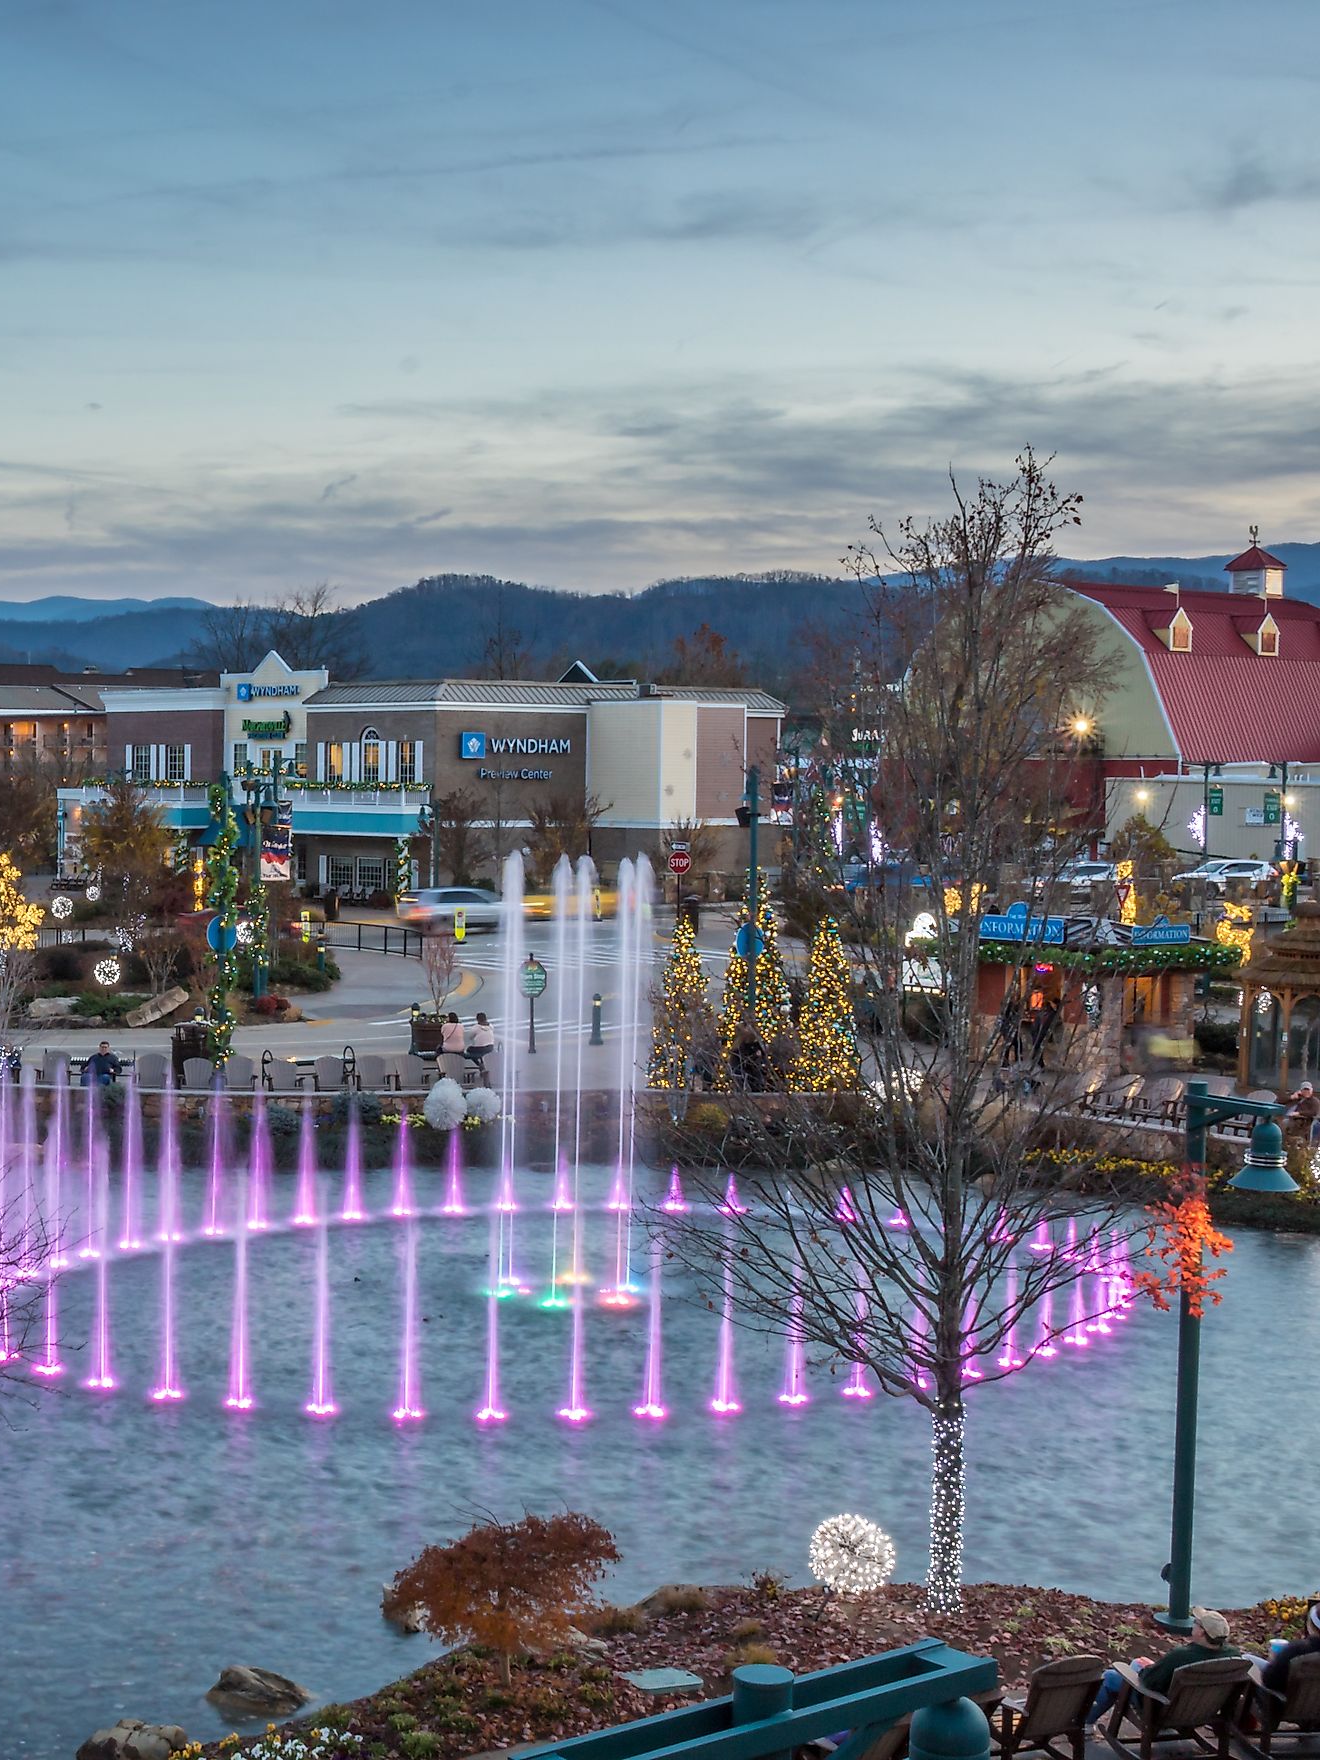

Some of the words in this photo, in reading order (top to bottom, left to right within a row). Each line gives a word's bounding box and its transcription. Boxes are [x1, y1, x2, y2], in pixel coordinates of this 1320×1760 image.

[251, 685, 299, 697] WYNDHAM
[491, 738, 571, 754] WYNDHAM
[480, 767, 518, 779] Preview
[520, 768, 553, 779] Center
[670, 858, 690, 868] STOP
